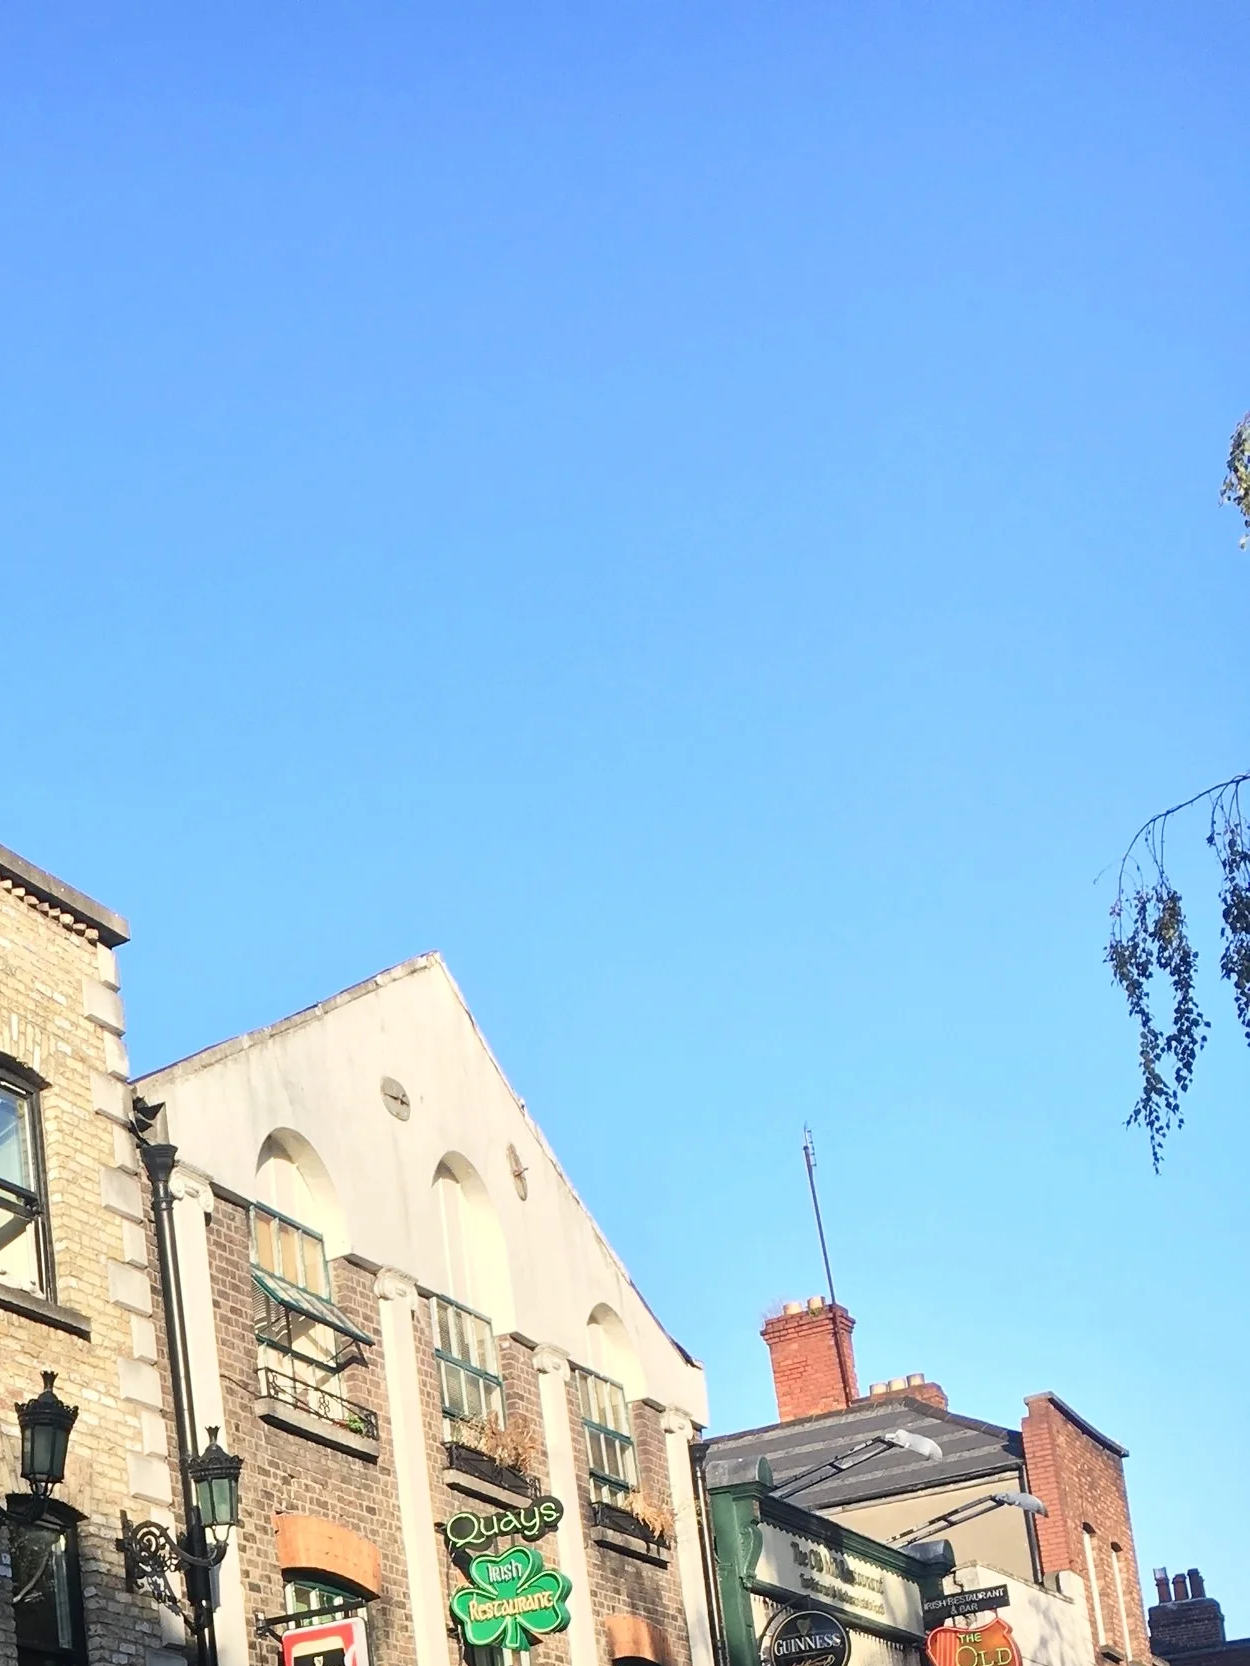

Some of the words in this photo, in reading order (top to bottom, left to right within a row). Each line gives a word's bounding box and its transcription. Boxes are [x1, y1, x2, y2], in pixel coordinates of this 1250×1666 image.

[446, 1502, 560, 1547] Quays
[923, 1600, 946, 1610] IRISH
[947, 1587, 1004, 1606] RESTAURANT
[960, 1603, 978, 1613] BAR
[774, 1633, 843, 1656] GUINNESS
[958, 1632, 982, 1643] THE
